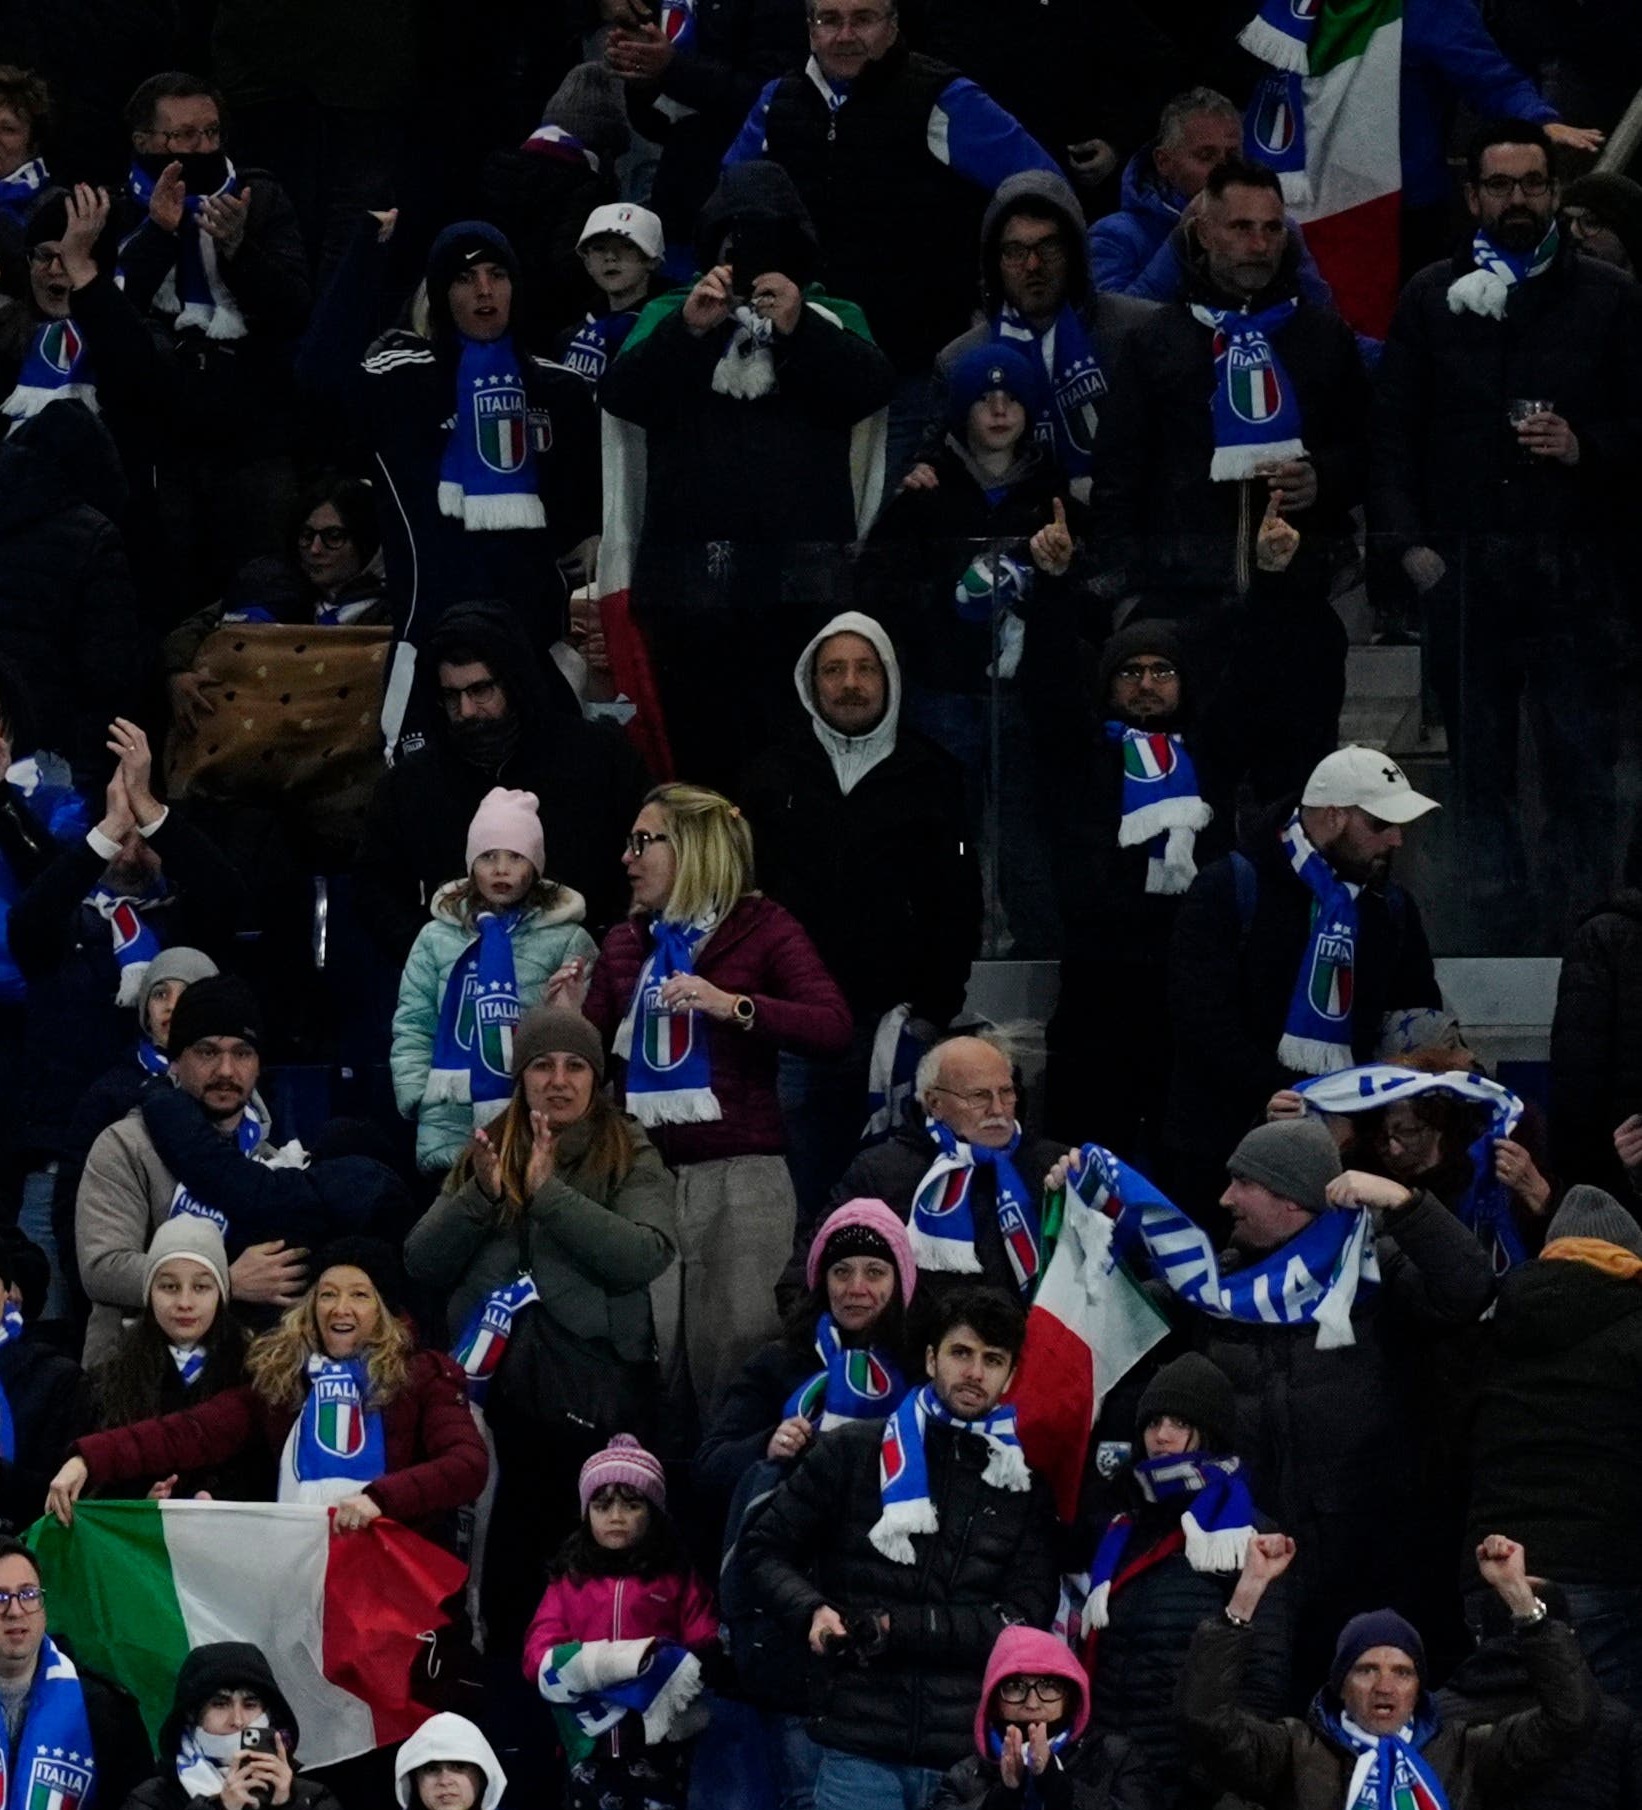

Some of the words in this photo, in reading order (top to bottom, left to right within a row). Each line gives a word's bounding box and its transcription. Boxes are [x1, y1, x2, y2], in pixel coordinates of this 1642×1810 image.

[567, 352, 598, 375] ALIA
[477, 396, 523, 413] ITALIA
[482, 1303, 512, 1332] ALIA
[35, 1762, 84, 1792] ITALIA
